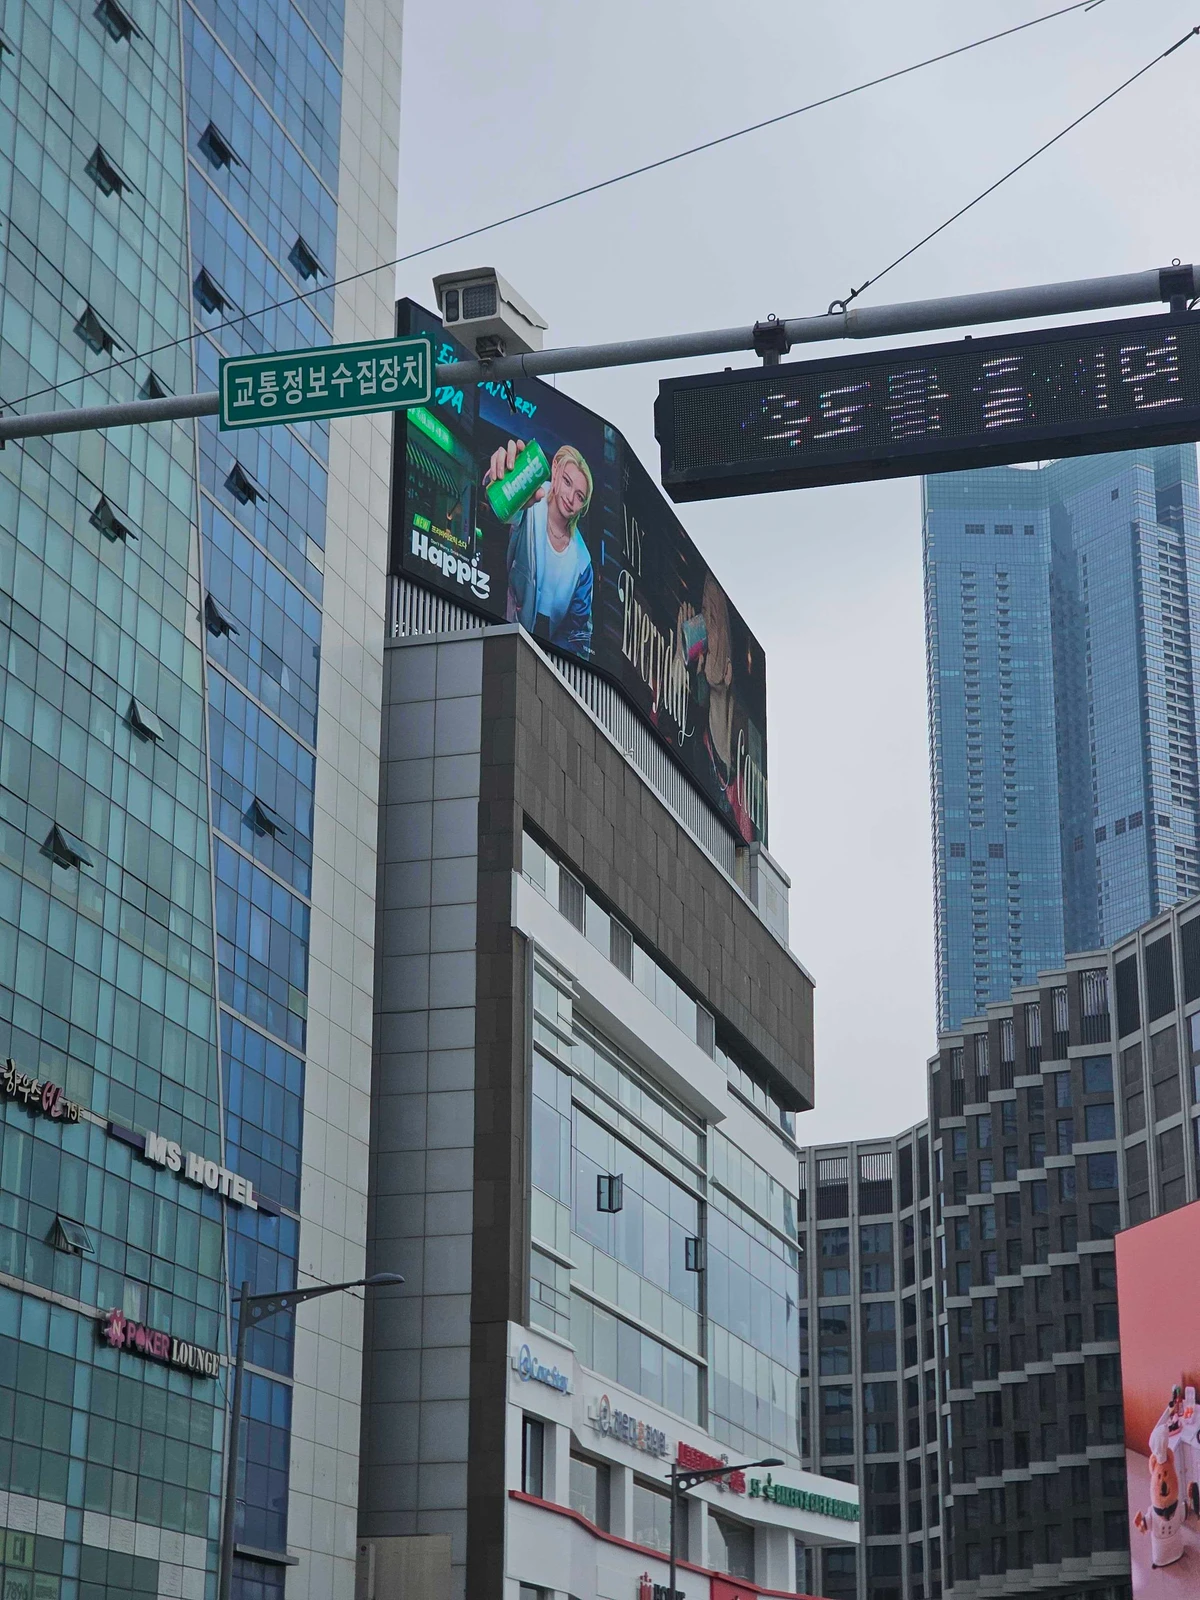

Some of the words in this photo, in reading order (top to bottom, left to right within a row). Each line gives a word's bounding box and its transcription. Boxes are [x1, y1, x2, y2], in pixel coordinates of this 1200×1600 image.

[233, 352, 423, 408] 교통정보수집장치
[414, 515, 430, 530] NEW
[412, 529, 490, 596] Happiz
[618, 569, 695, 748] Everyday
[145, 1130, 182, 1172] MS
[185, 1151, 258, 1211] HOTEL
[172, 1338, 220, 1377] LOUNGE
